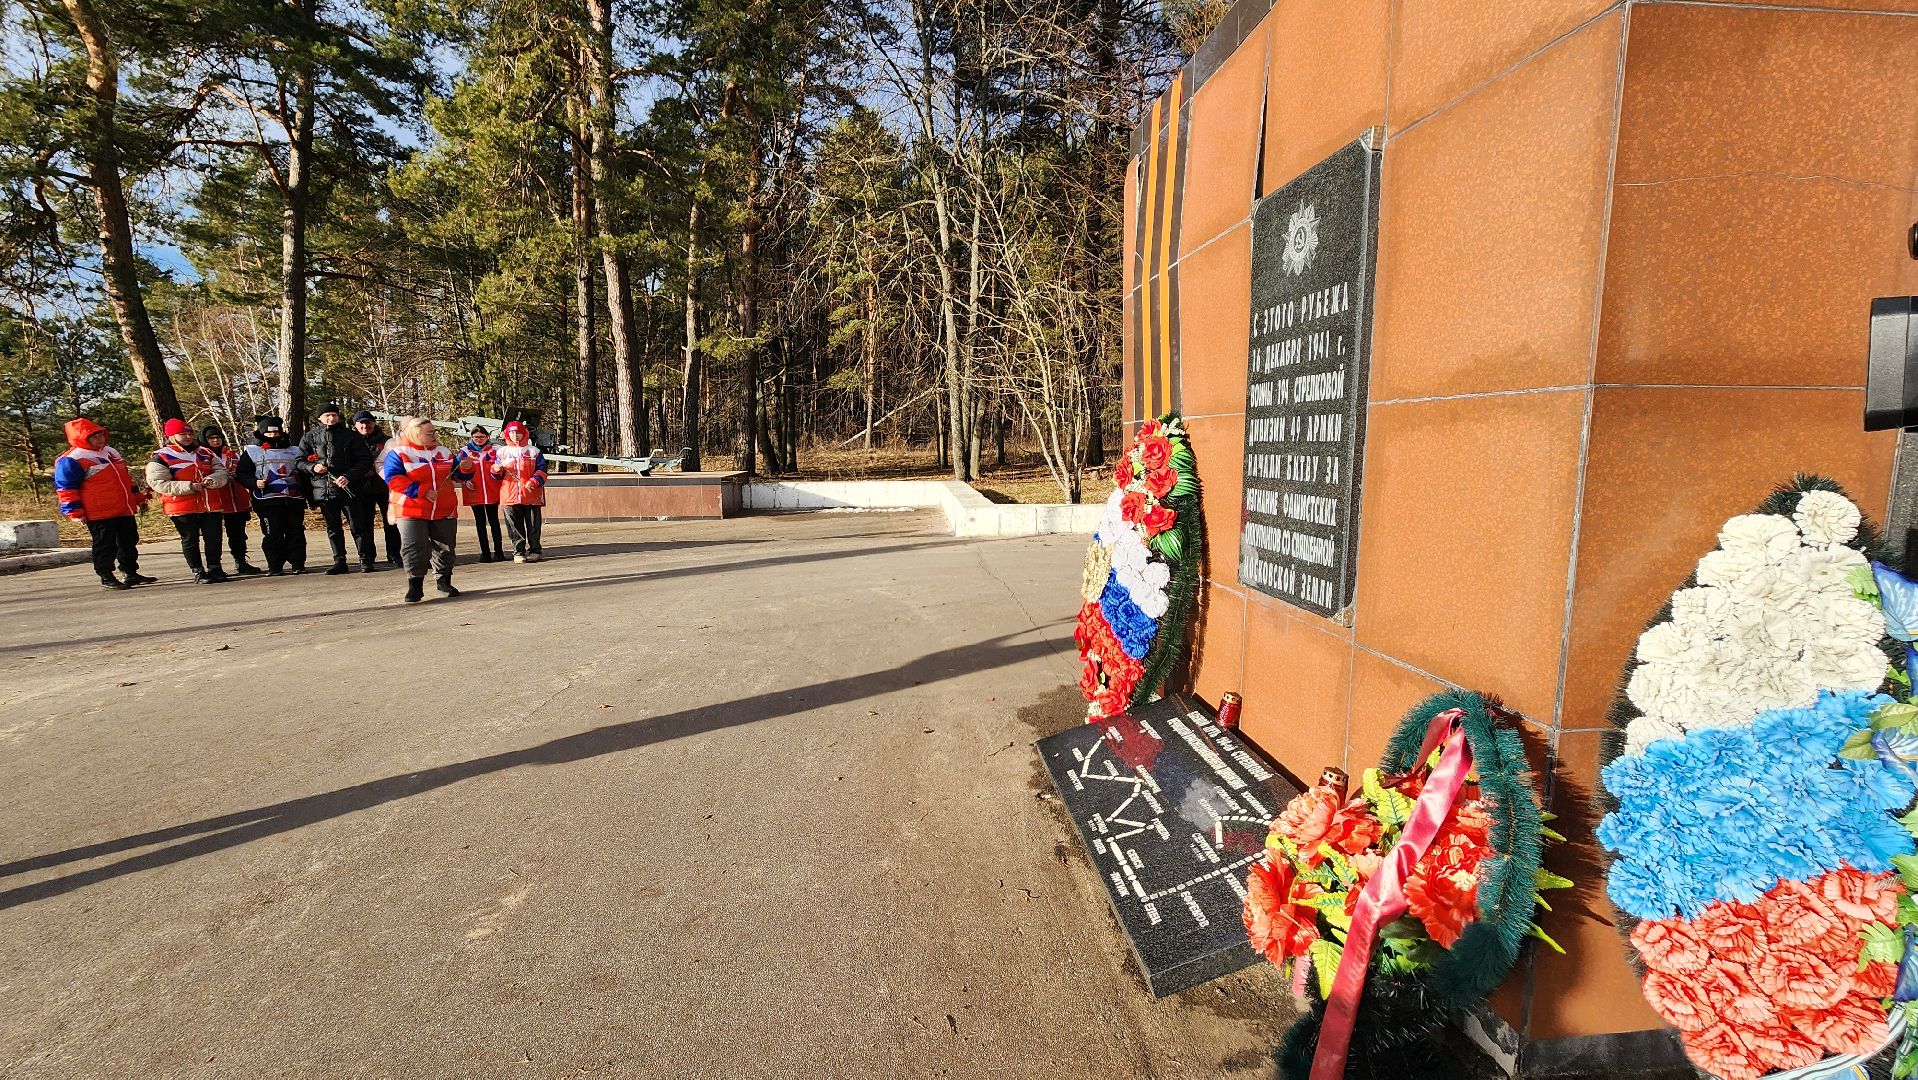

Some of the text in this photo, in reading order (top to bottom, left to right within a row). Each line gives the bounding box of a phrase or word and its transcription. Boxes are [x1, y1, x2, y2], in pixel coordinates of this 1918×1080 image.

[1254, 281, 1349, 338] С ЭТОГО РУБЕЖА
[1252, 348, 1261, 372] 16
[1264, 337, 1302, 374] ДЕКАБРЯ
[1308, 330, 1330, 361] 1941
[1250, 381, 1274, 408] ВОИНЫ
[1293, 363, 1345, 404] СТРЕЛКОВОЙ
[1248, 413, 1342, 447] ДИВИЗИИ 49 АРМИИ
[1247, 453, 1339, 484] НАЧАЛИ БИТВУ ЗА
[1246, 488, 1338, 527] ИЗГНАНИЕ ФАШИСТСКИХ
[1281, 529, 1291, 556] СО
[1291, 531, 1335, 568] СВЯЩЕННОЙ
[1243, 555, 1333, 610] МОСКОВСКОЙ ЗЕМЛИ
[1191, 832, 1221, 864] СЕРПУХОВ
[1143, 902, 1163, 926] ЕЛЕЦ
